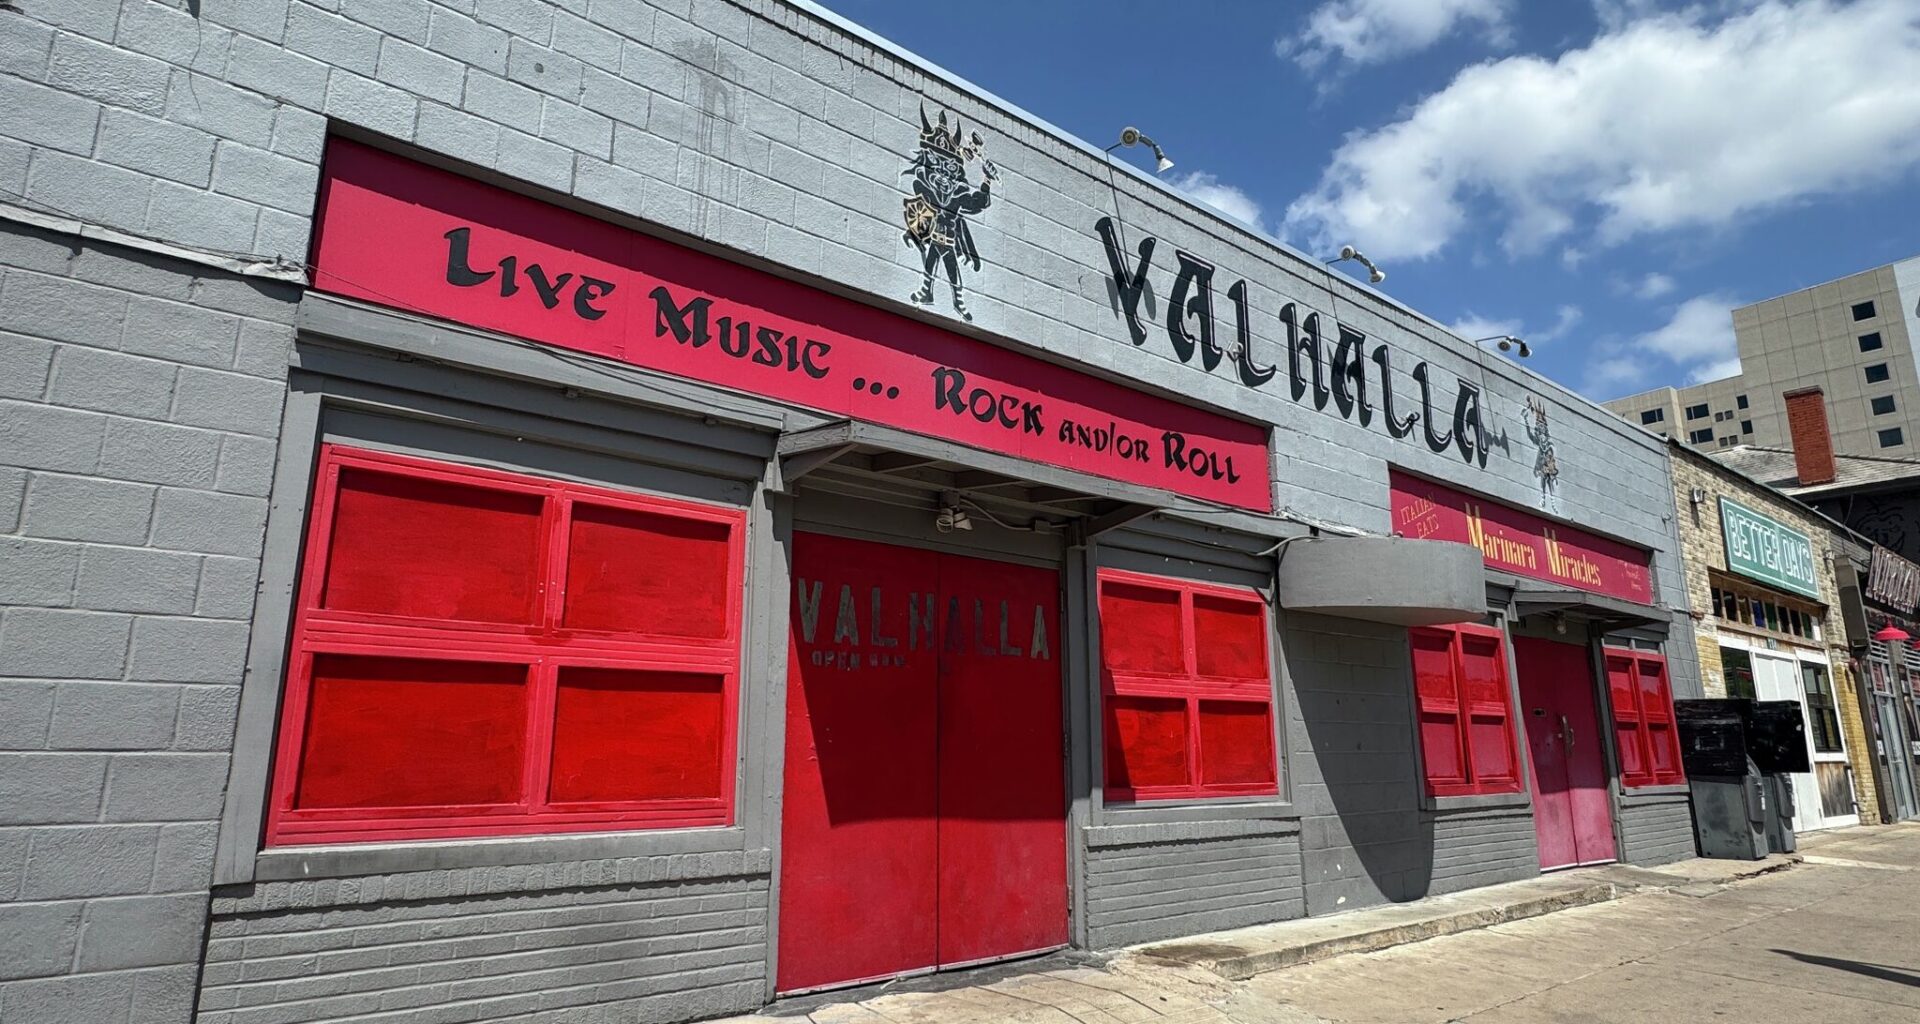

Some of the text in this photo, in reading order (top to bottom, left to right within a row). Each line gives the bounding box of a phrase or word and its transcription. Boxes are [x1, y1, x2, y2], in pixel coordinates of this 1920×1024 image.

[1095, 216, 1489, 470] VALHALLA
[1400, 492, 1436, 525] ITALIAN
[1416, 514, 1439, 539] EATS
[1465, 502, 1537, 570] Marinara
[1543, 527, 1602, 587] Miracles
[1727, 509, 1783, 572] BETTER
[1781, 533, 1813, 584] DAYS
[798, 577, 1050, 660] VALHALLA
